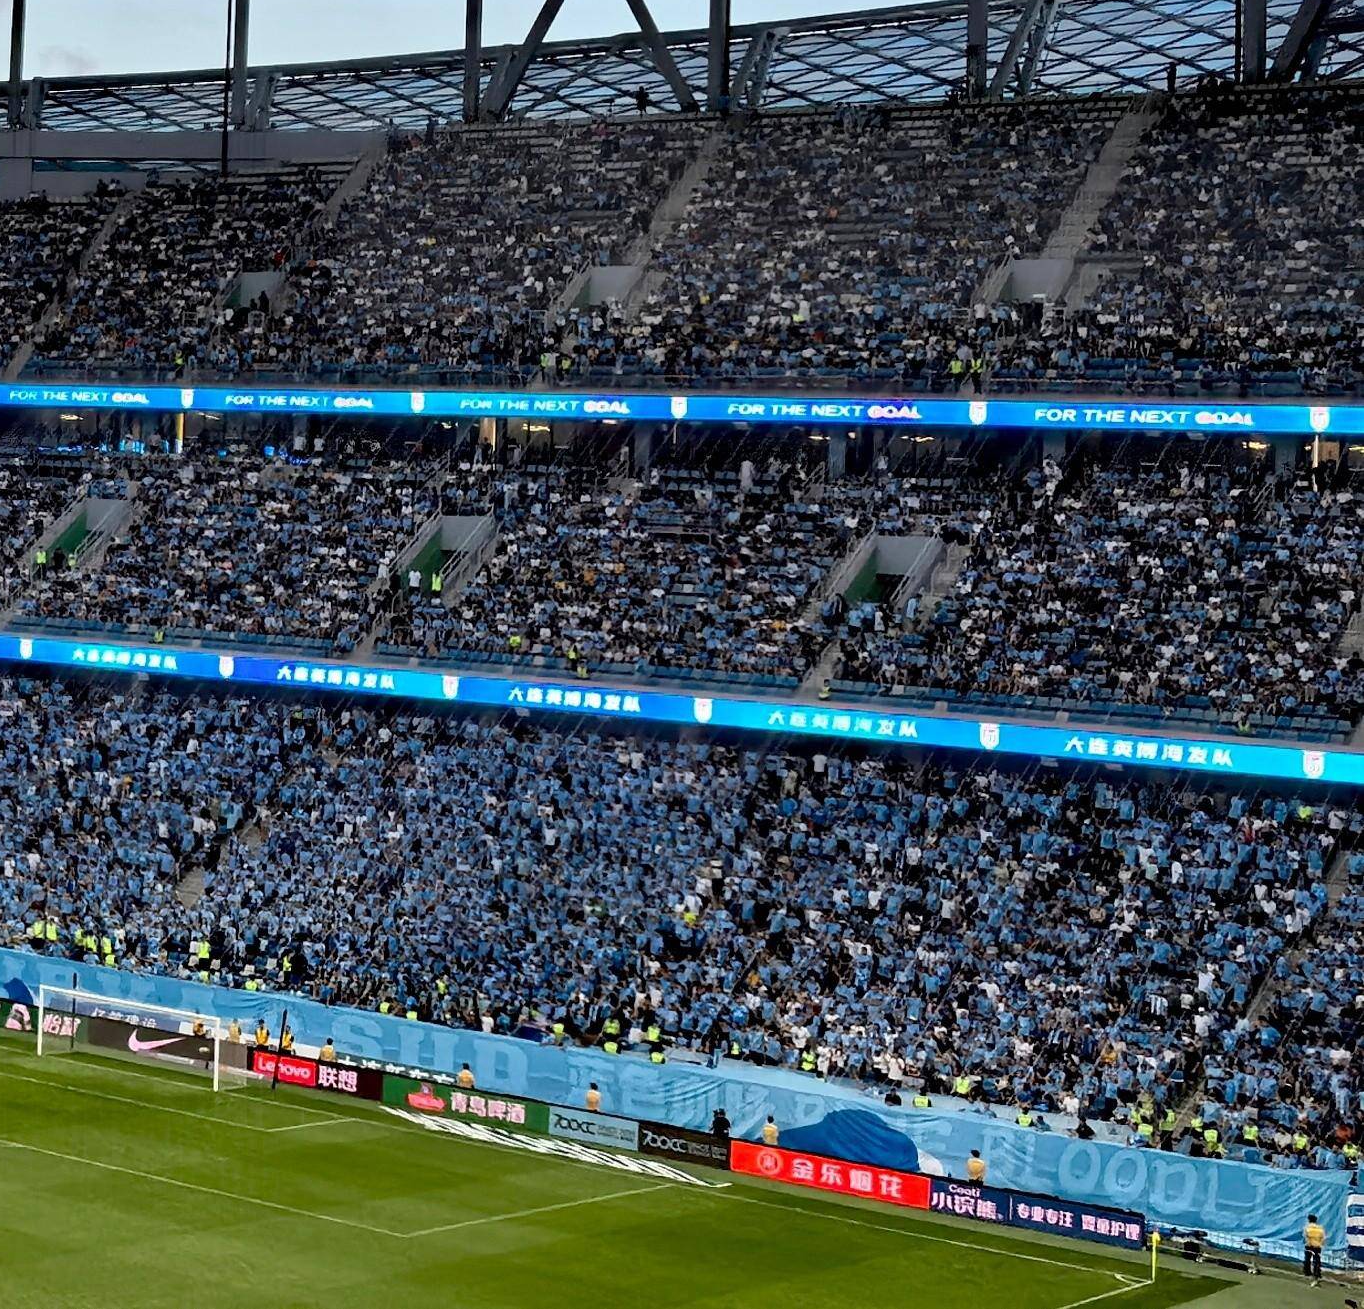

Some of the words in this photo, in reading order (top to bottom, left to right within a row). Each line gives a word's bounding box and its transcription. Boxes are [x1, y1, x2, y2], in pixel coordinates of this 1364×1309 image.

[9, 390, 36, 400] FOR
[42, 391, 67, 401] THE
[71, 391, 109, 402] NEXT
[225, 395, 253, 405] FOR
[258, 395, 286, 406] THE
[290, 396, 328, 407] NEXT
[460, 400, 492, 409] FOR
[498, 400, 529, 411] THE
[533, 400, 579, 411] NEXT
[584, 400, 629, 414] GOAL
[727, 404, 764, 415] FOR
[771, 404, 807, 416] THE
[811, 404, 864, 417] NEXT
[867, 405, 922, 419] GOAL
[1034, 408, 1077, 422] FOR
[1084, 409, 1124, 423] THE
[1129, 409, 1189, 424] NEXT
[1195, 411, 1253, 426] GOAL
[278, 666, 393, 689] 大连英博海发队
[510, 687, 640, 712] 大连英博海发队
[769, 711, 917, 738] 大连英博海发队
[1066, 737, 1231, 766] 大连英博海发队
[318, 1065, 358, 1092] 联想
[450, 1090, 526, 1125] 青岛啤酒
[791, 1156, 902, 1199] 金乐烟花
[1016, 1203, 1073, 1228] 专业专注
